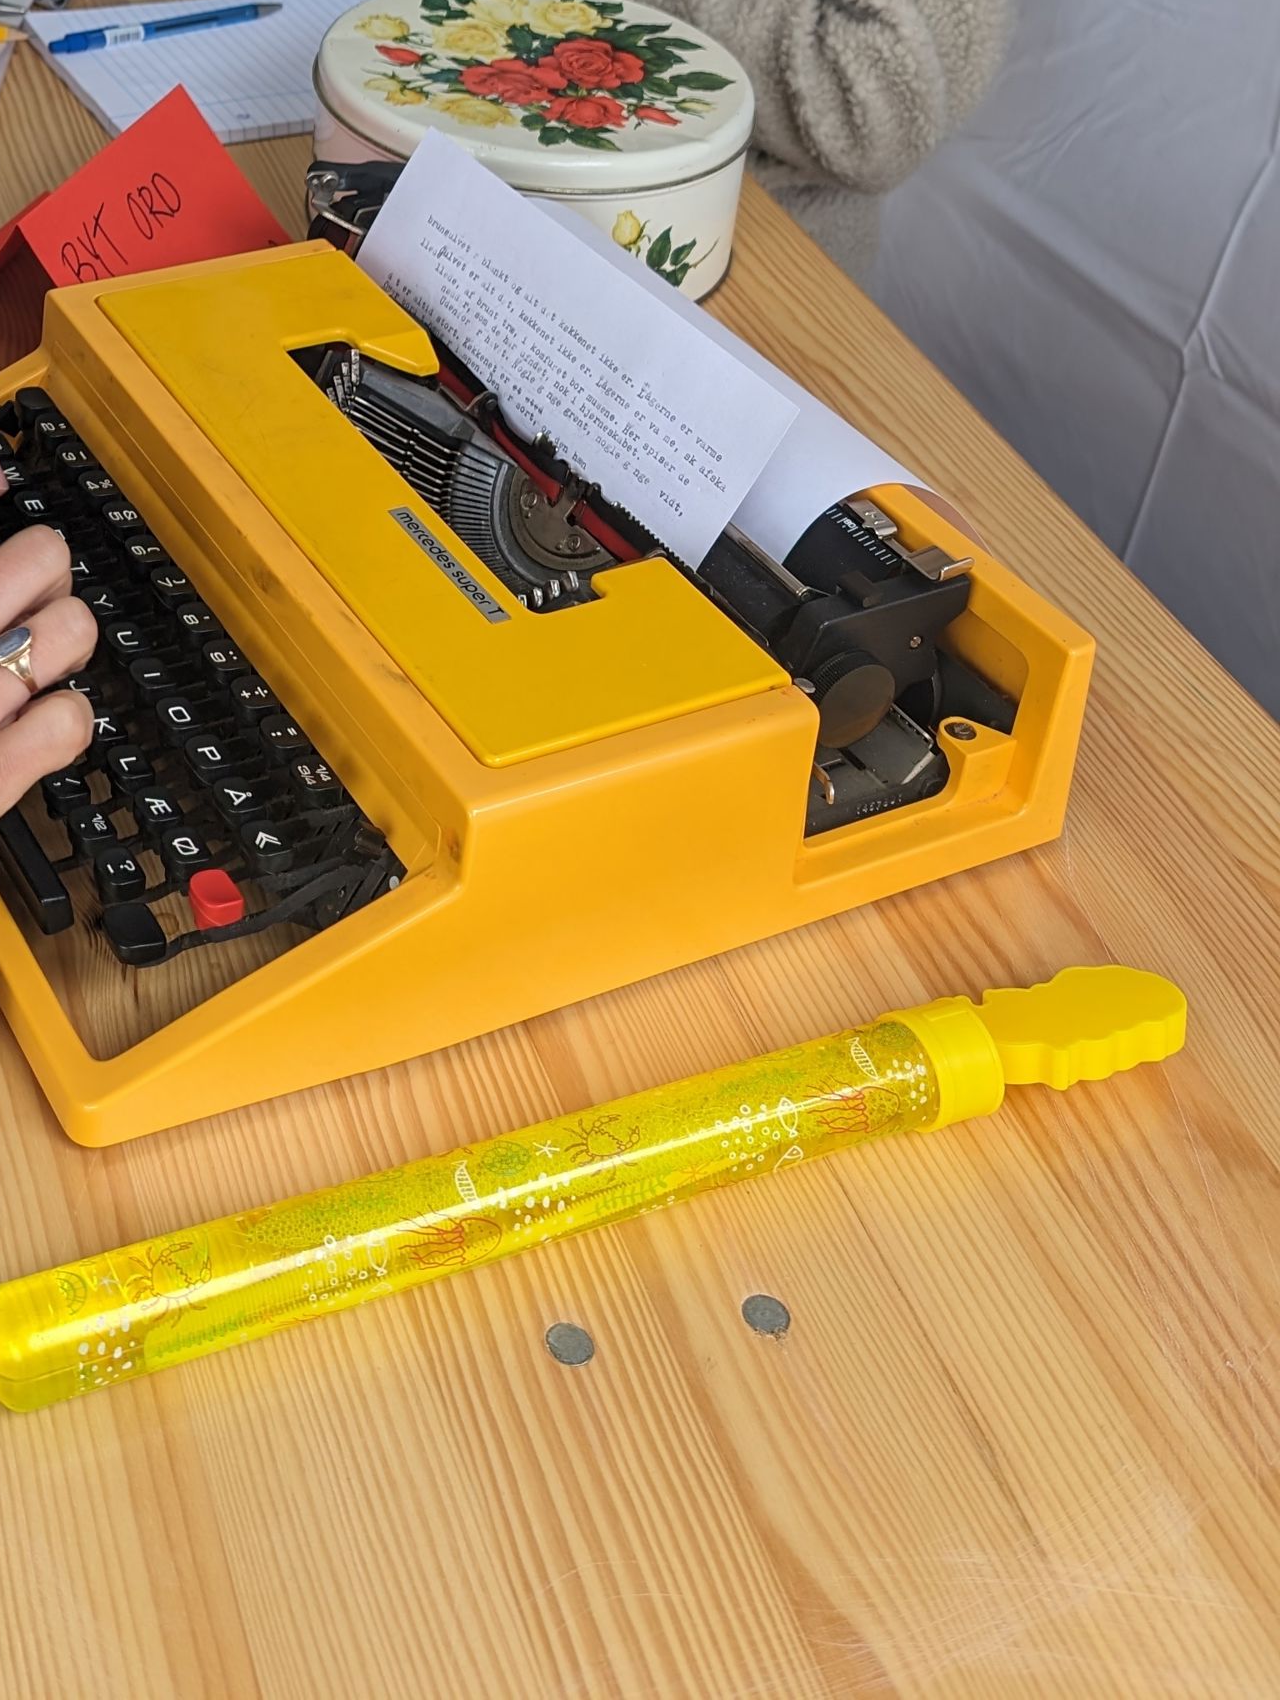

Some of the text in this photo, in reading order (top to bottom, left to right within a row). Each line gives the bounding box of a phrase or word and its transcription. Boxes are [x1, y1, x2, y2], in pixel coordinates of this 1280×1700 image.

[61, 173, 182, 284] BYT ORD
[467, 269, 480, 281] er
[556, 342, 577, 364] ikke
[632, 409, 647, 422] er
[551, 379, 570, 397] nok
[597, 352, 619, 374] ikke
[679, 422, 693, 436] er
[694, 435, 723, 463] varme
[620, 421, 641, 442] Her
[40, 421, 56, 432] 2
[86, 480, 100, 490] 4
[131, 545, 146, 555] 6
[183, 614, 199, 625] 8
[209, 652, 227, 663] 9
[397, 511, 456, 569] mercedes
[452, 570, 491, 605] super
[4, 466, 25, 482] W
[24, 499, 44, 511] E
[71, 561, 90, 575] T
[93, 594, 114, 608] Y
[117, 631, 139, 646] U
[168, 706, 192, 723] O
[197, 746, 221, 761] P
[224, 788, 253, 806] Å
[69, 680, 91, 691] J
[94, 717, 117, 734] K
[119, 756, 137, 771] L
[145, 797, 172, 816] Æ
[172, 837, 199, 856] Ø
